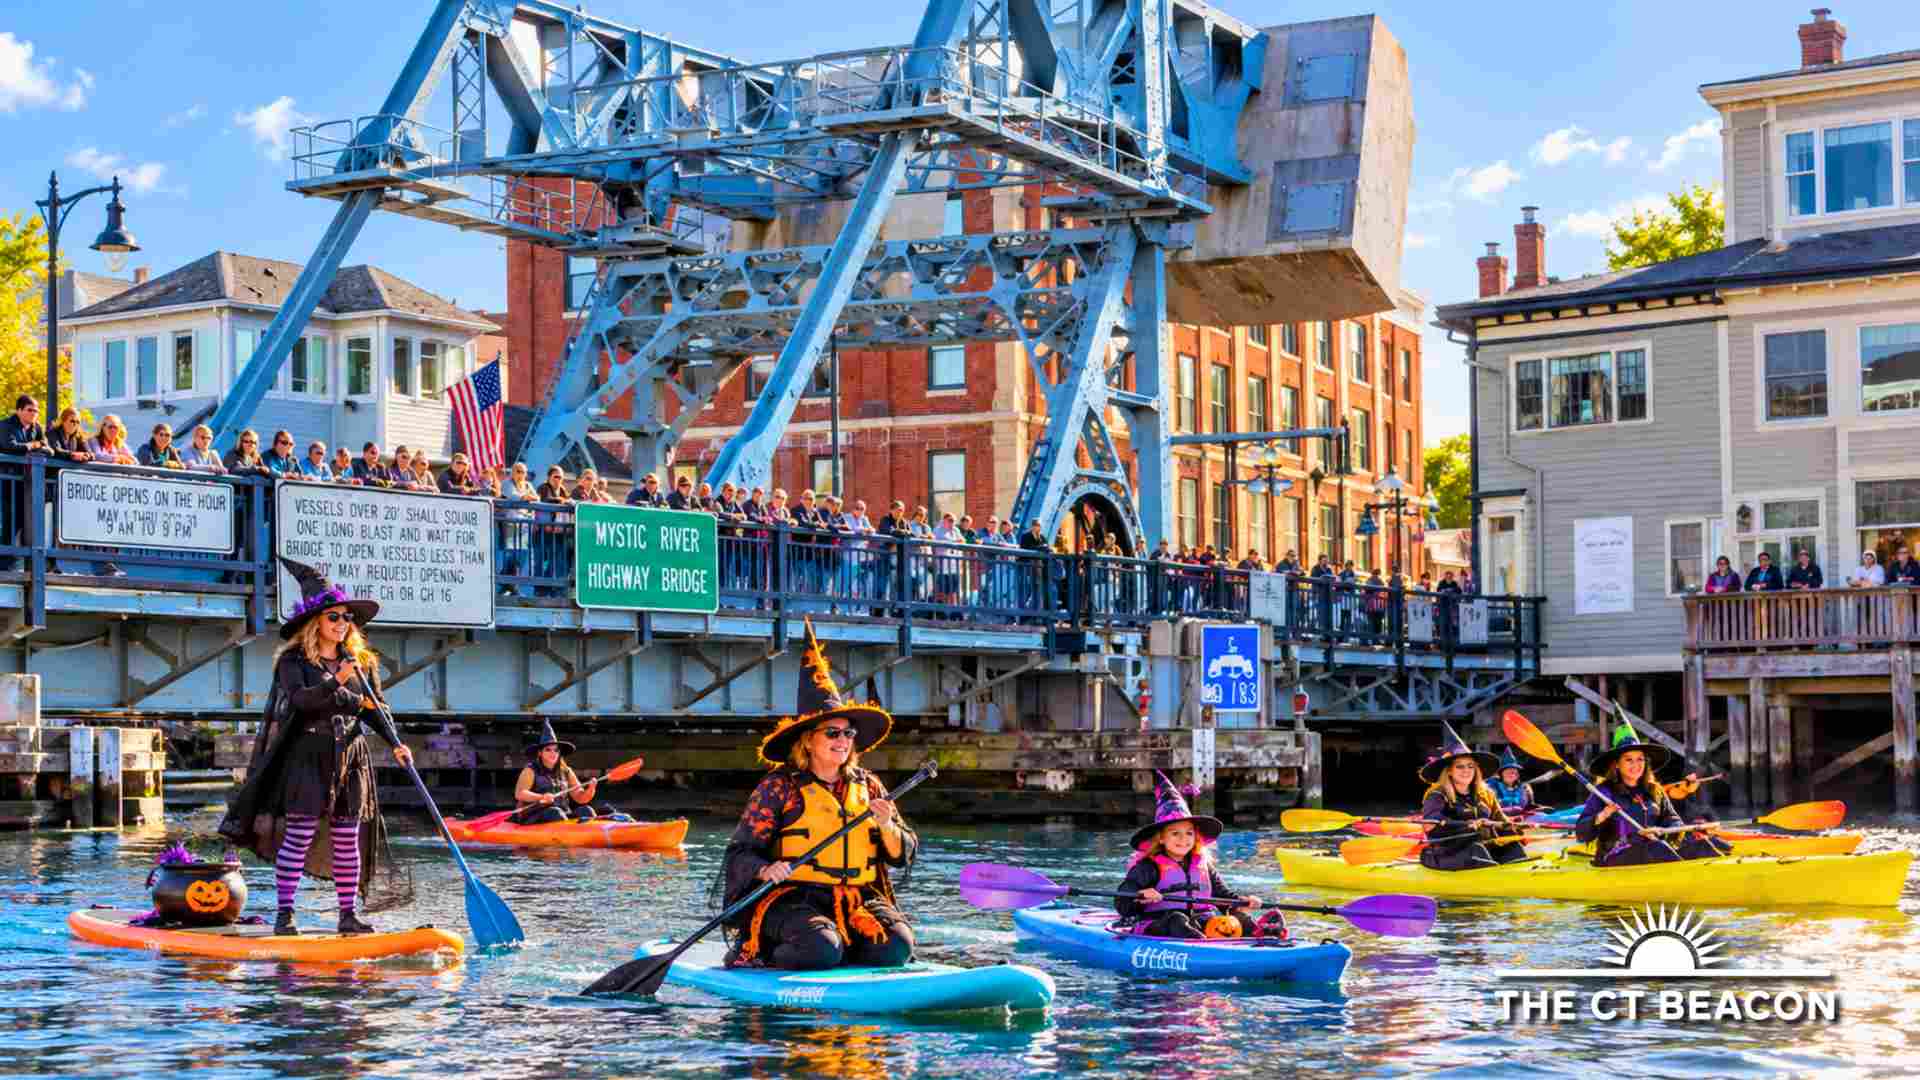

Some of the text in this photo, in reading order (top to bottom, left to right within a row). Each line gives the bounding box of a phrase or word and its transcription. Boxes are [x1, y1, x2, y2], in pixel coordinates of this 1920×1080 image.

[67, 482, 226, 512] BRIDGE OPENS ON THE HOUR
[295, 499, 344, 517] VESSELS
[350, 503, 379, 519] OVER
[406, 507, 440, 525] SHALL
[175, 521, 192, 538] PM
[297, 519, 476, 546] ONE LONG BLAST AND WAIT FOR
[595, 520, 700, 552] MYSTIC RIVER
[286, 539, 324, 557] BRIDGE
[329, 542, 343, 558] TO
[382, 545, 426, 562] VESSELS
[430, 547, 456, 564] LESS
[459, 549, 485, 565] THAN
[338, 563, 361, 579] MAY
[367, 564, 413, 582] REQUEST
[419, 567, 465, 584] OPENING
[588, 562, 708, 594] HIGHWAY BRIDGE
[399, 586, 414, 601] OR
[421, 587, 434, 602] CH
[441, 588, 453, 602] 16
